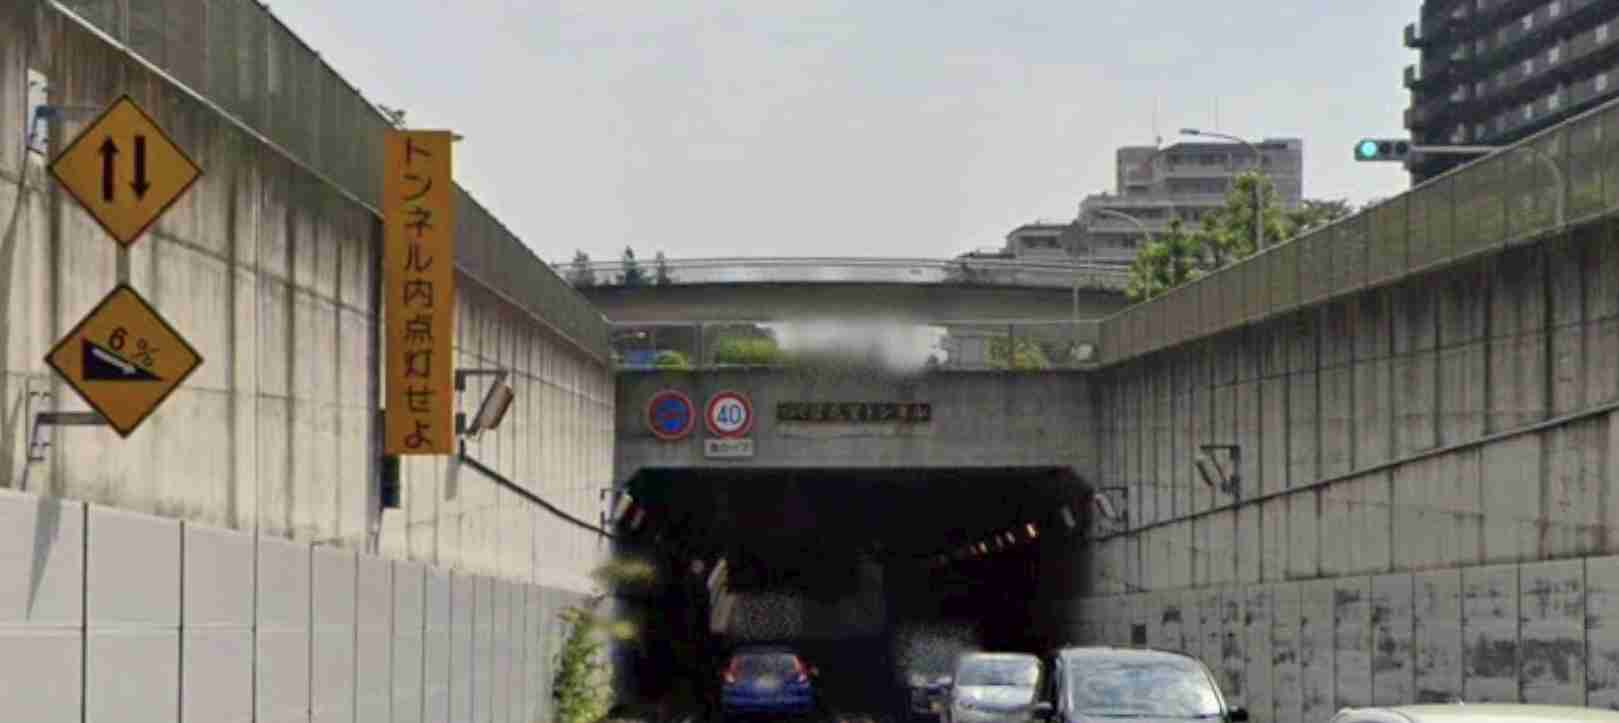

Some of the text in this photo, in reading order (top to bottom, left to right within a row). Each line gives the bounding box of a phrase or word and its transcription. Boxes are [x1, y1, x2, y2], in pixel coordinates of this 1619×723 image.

[402, 136, 434, 450] トンネル内点灯せよ
[716, 404, 742, 425] 40
